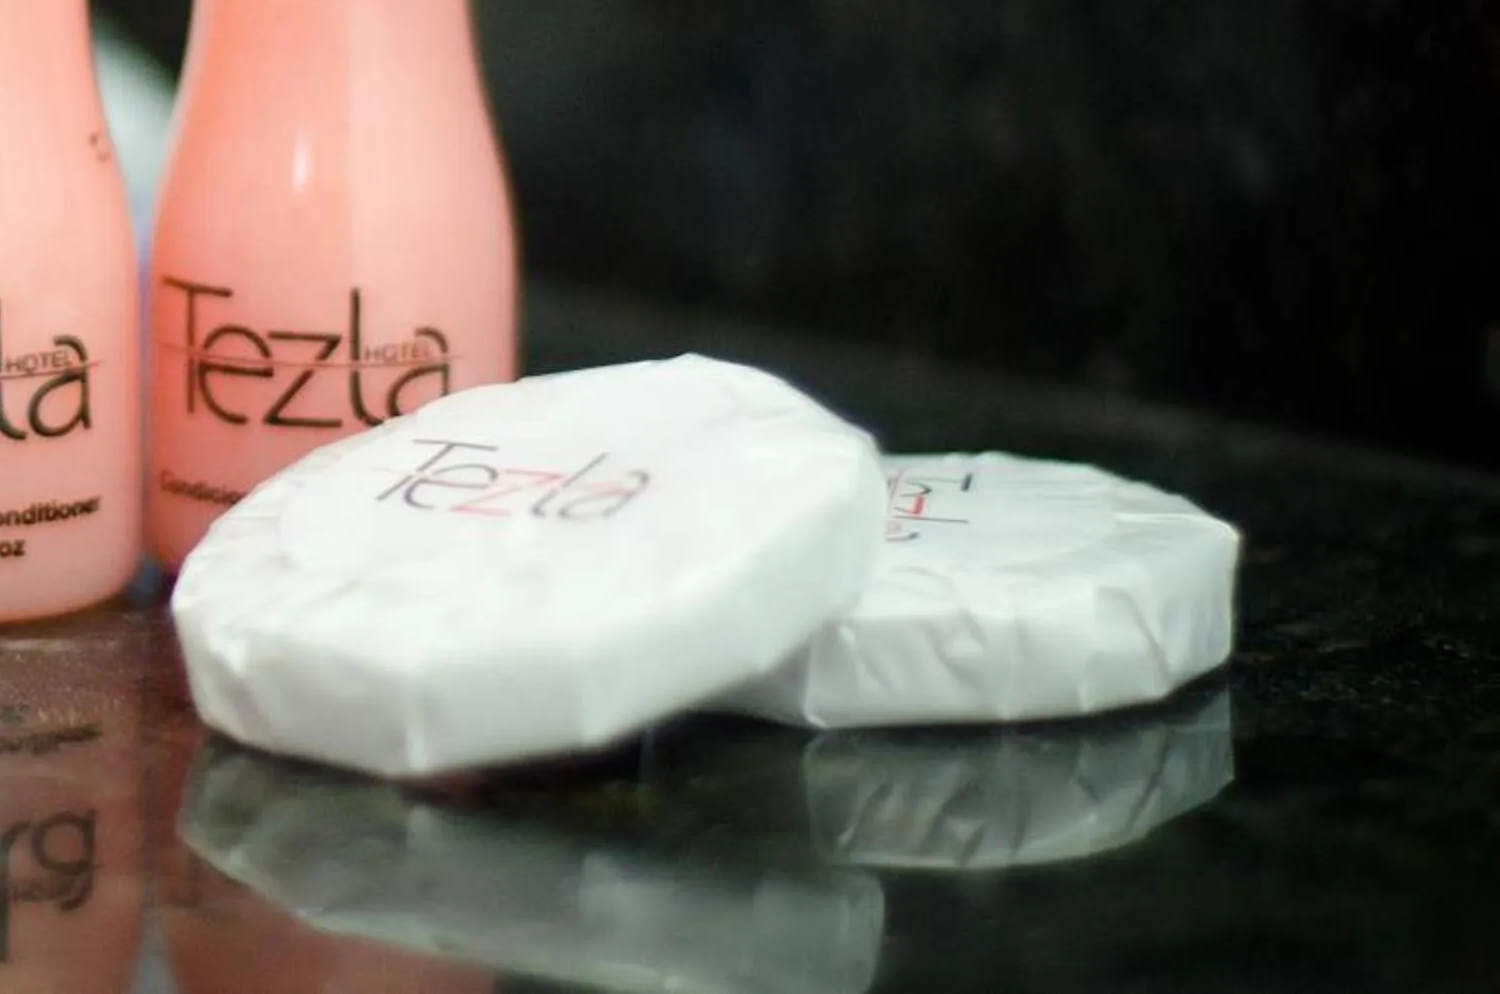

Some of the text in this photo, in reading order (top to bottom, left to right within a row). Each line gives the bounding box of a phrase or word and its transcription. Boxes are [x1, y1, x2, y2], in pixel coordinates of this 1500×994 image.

[5, 351, 73, 373] HOTEL
[163, 277, 449, 427] Tezla
[376, 438, 651, 520] Tezla
